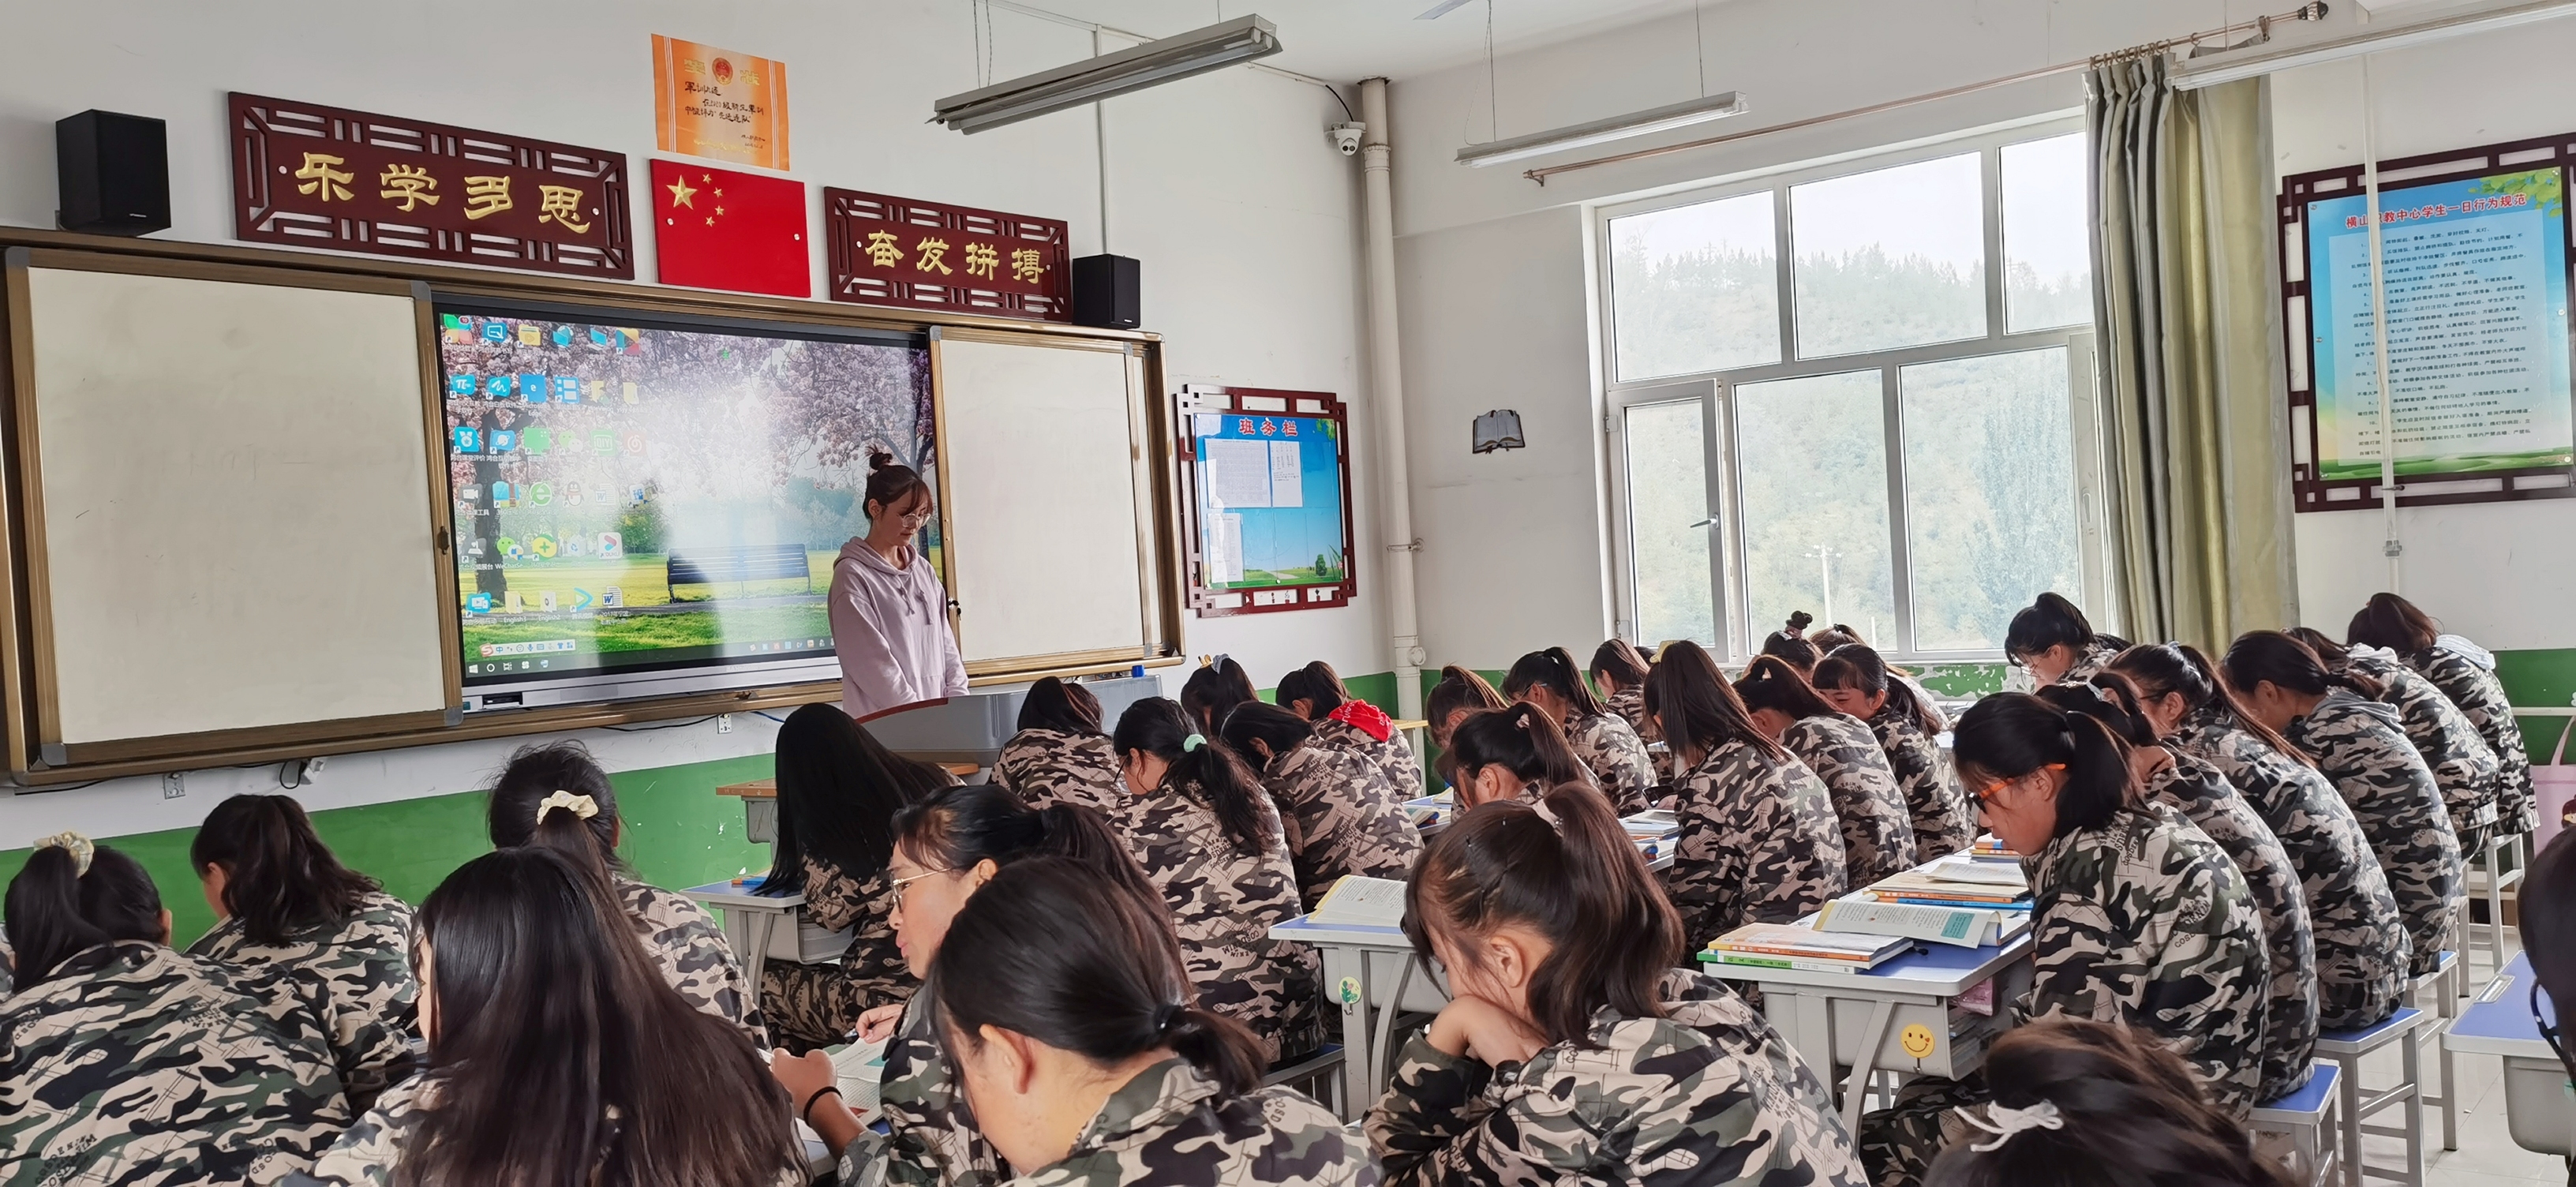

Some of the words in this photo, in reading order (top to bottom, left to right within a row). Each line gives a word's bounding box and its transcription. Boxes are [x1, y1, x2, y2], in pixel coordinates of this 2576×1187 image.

[295, 152, 592, 234] 乐学多思
[864, 230, 1045, 285] 奋发拼搏
[1238, 418, 1298, 436] 班务栏
